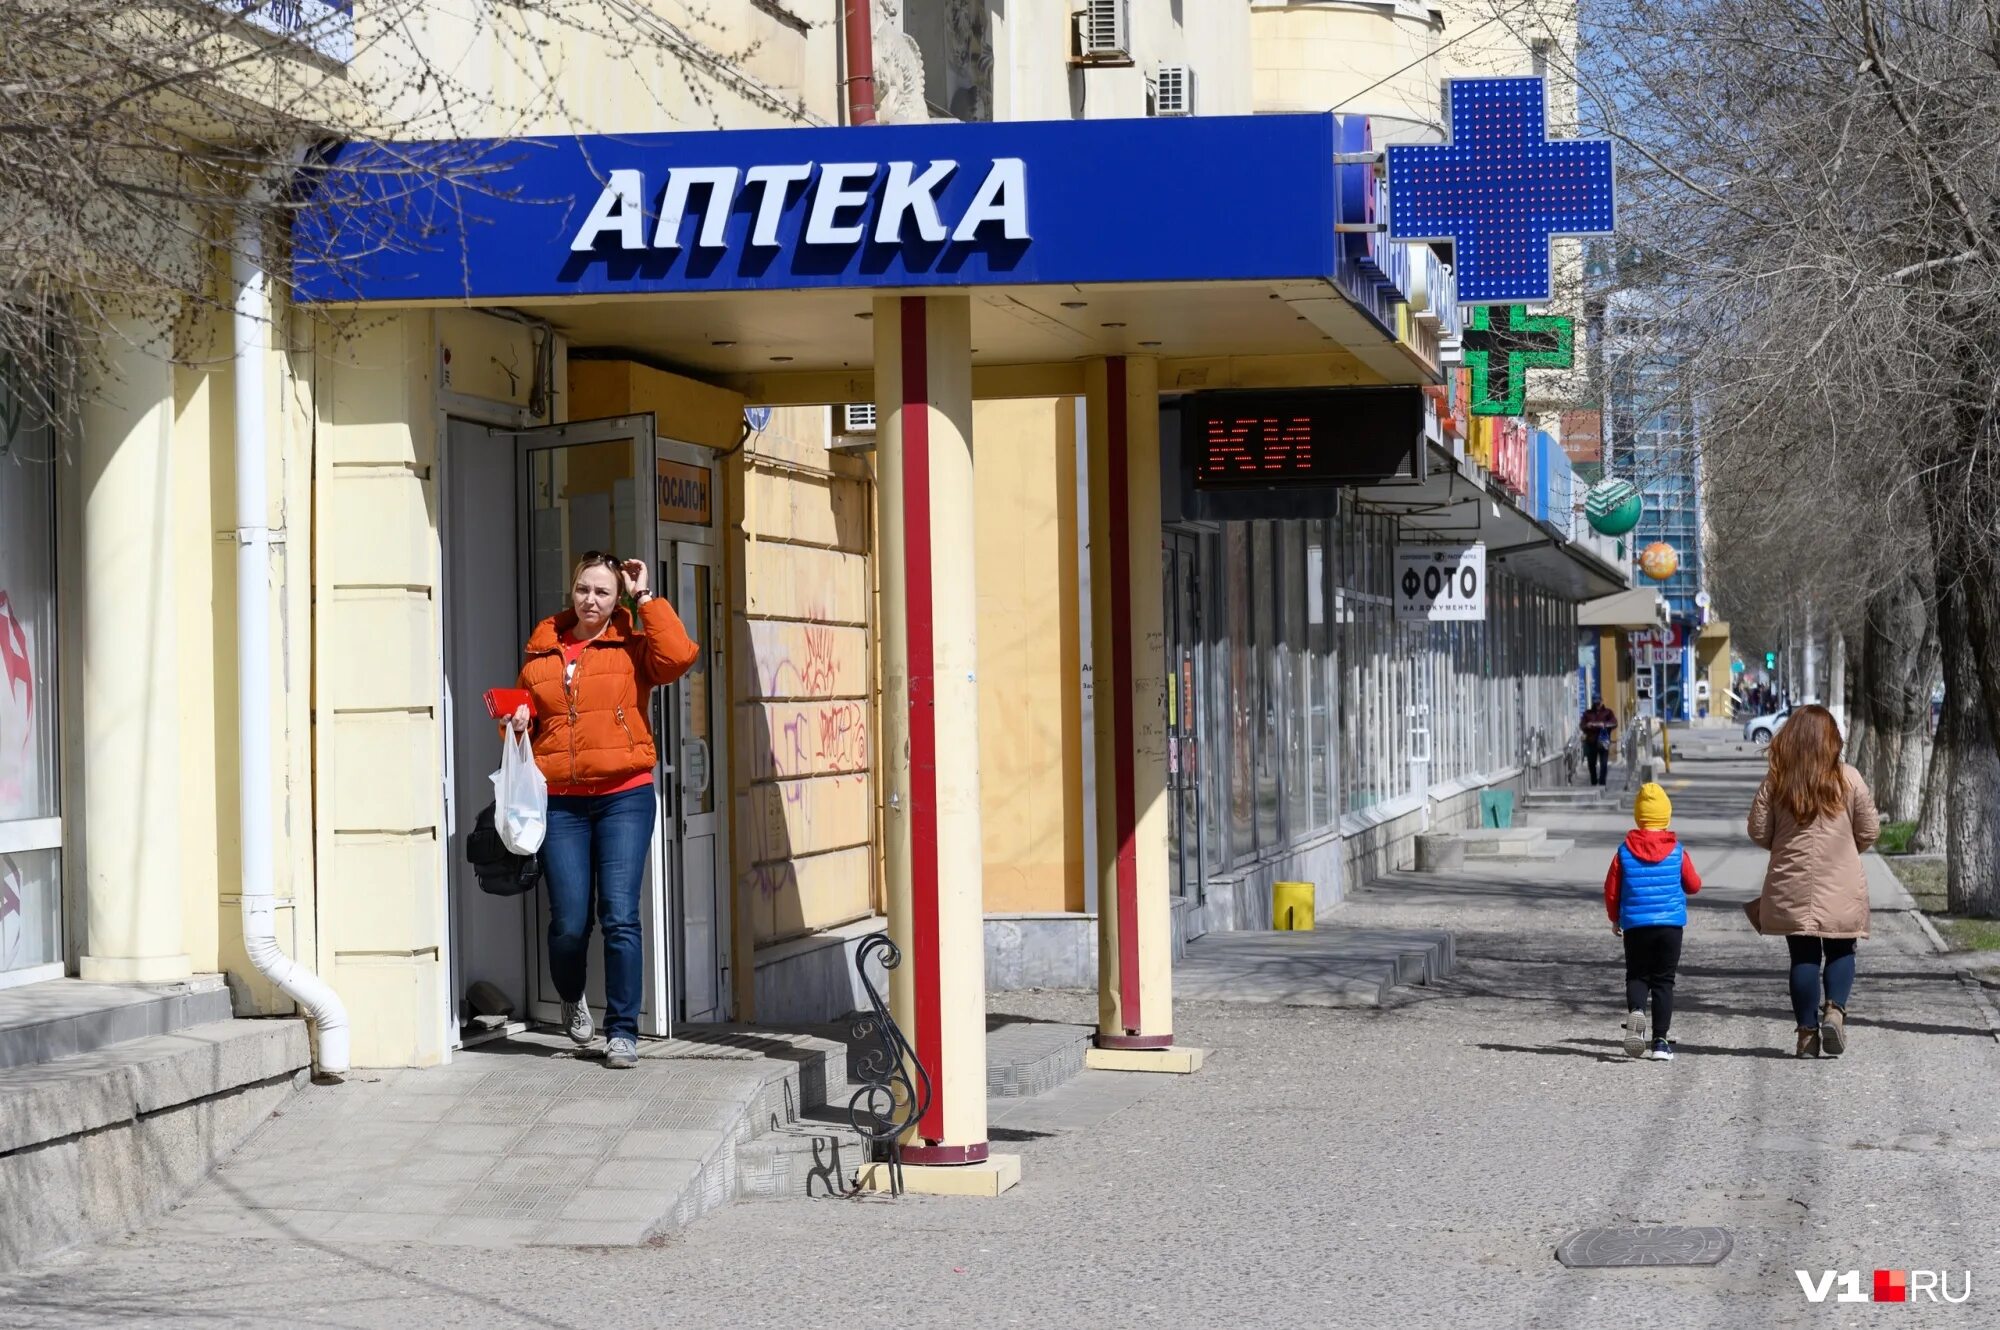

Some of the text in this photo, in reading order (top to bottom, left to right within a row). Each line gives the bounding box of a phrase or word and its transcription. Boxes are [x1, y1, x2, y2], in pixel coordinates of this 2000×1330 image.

[570, 157, 1033, 251] АПТЕКА
[1401, 565, 1477, 600] ФОТО
[1402, 604, 1477, 612] НА ДОКУМЕНТЫ
